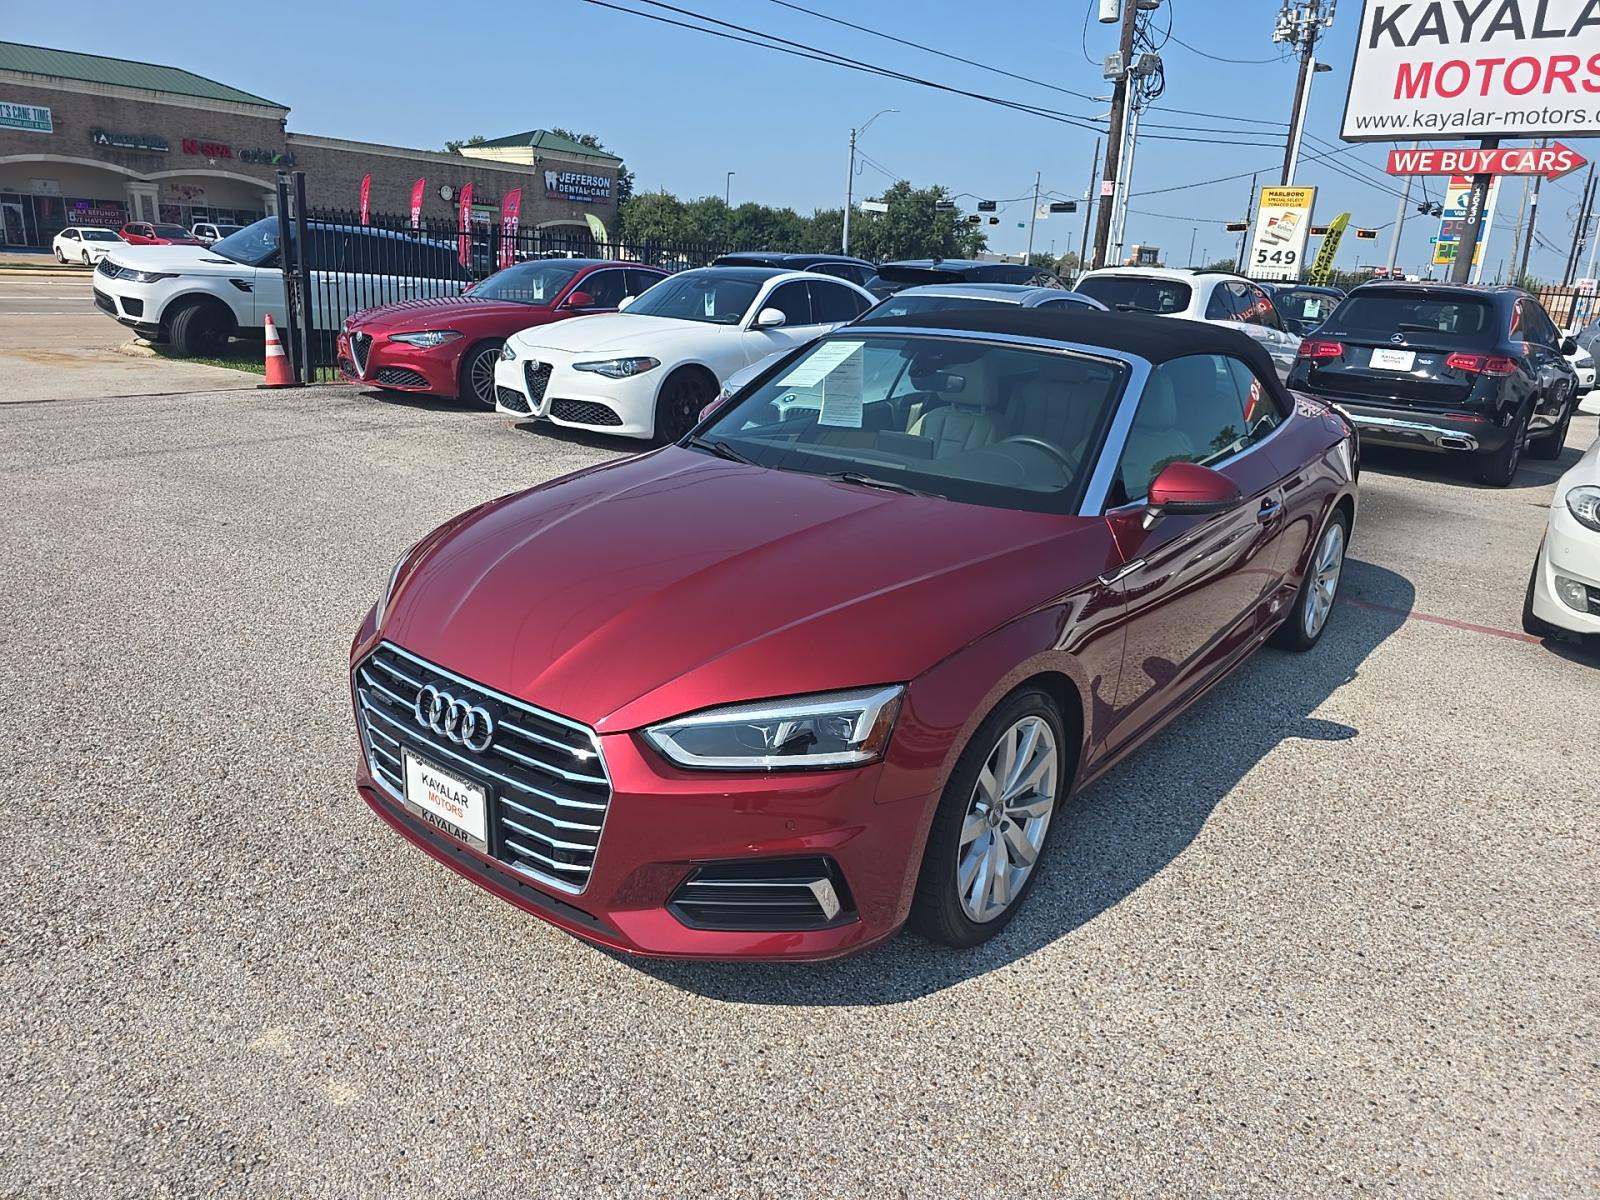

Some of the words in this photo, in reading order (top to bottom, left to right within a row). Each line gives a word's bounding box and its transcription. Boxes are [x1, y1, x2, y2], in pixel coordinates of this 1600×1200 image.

[1394, 151, 1435, 172] WE
[1440, 150, 1498, 172] BUY
[1500, 150, 1574, 172] CARS
[559, 172, 611, 188] JEFFERSON
[422, 772, 469, 809] KAYALAR
[428, 790, 464, 819] MOTORS
[422, 810, 470, 843] KAYALAR
